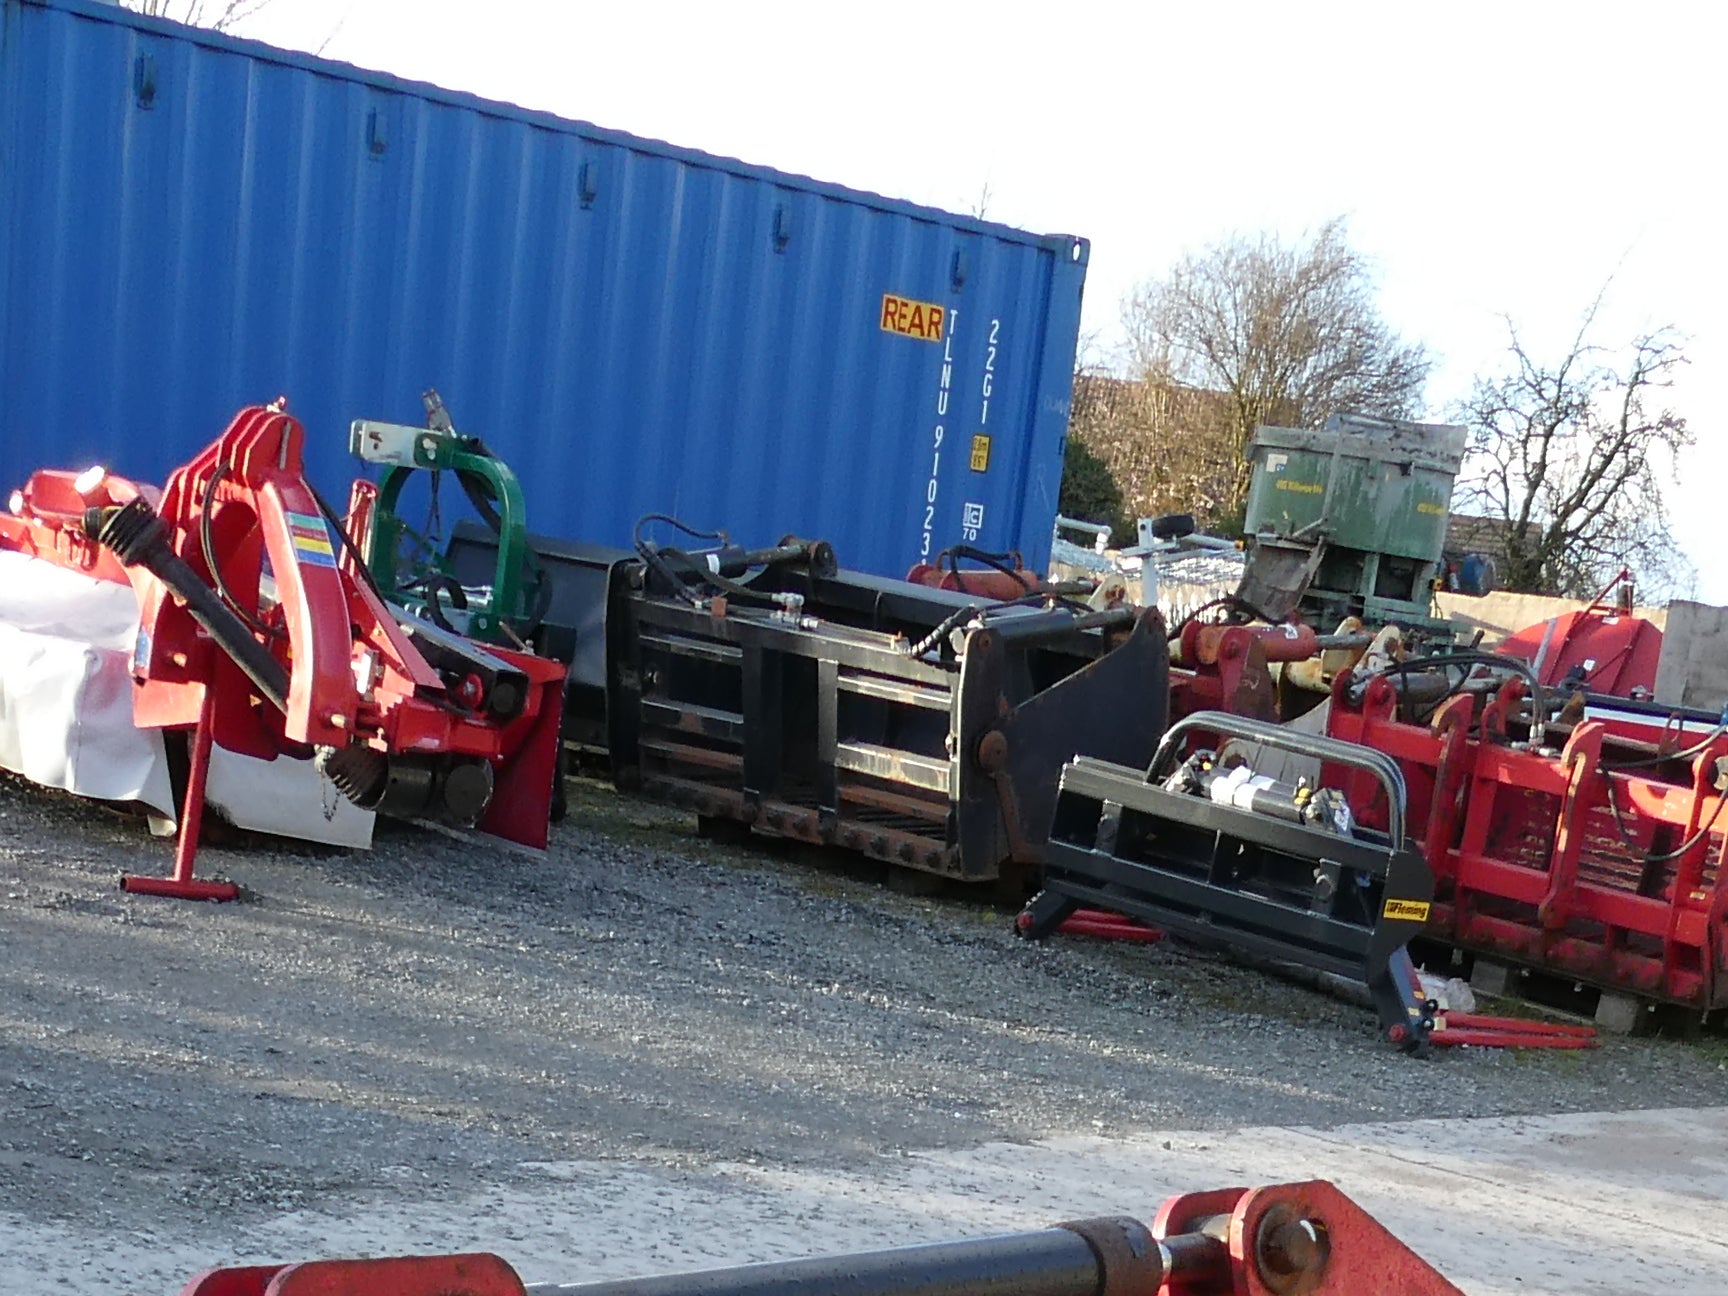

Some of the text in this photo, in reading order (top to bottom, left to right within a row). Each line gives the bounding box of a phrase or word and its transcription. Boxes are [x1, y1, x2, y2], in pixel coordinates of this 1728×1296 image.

[882, 298, 944, 340] REAR
[937, 309, 959, 416] TLNU
[981, 318, 1000, 425] 22G1
